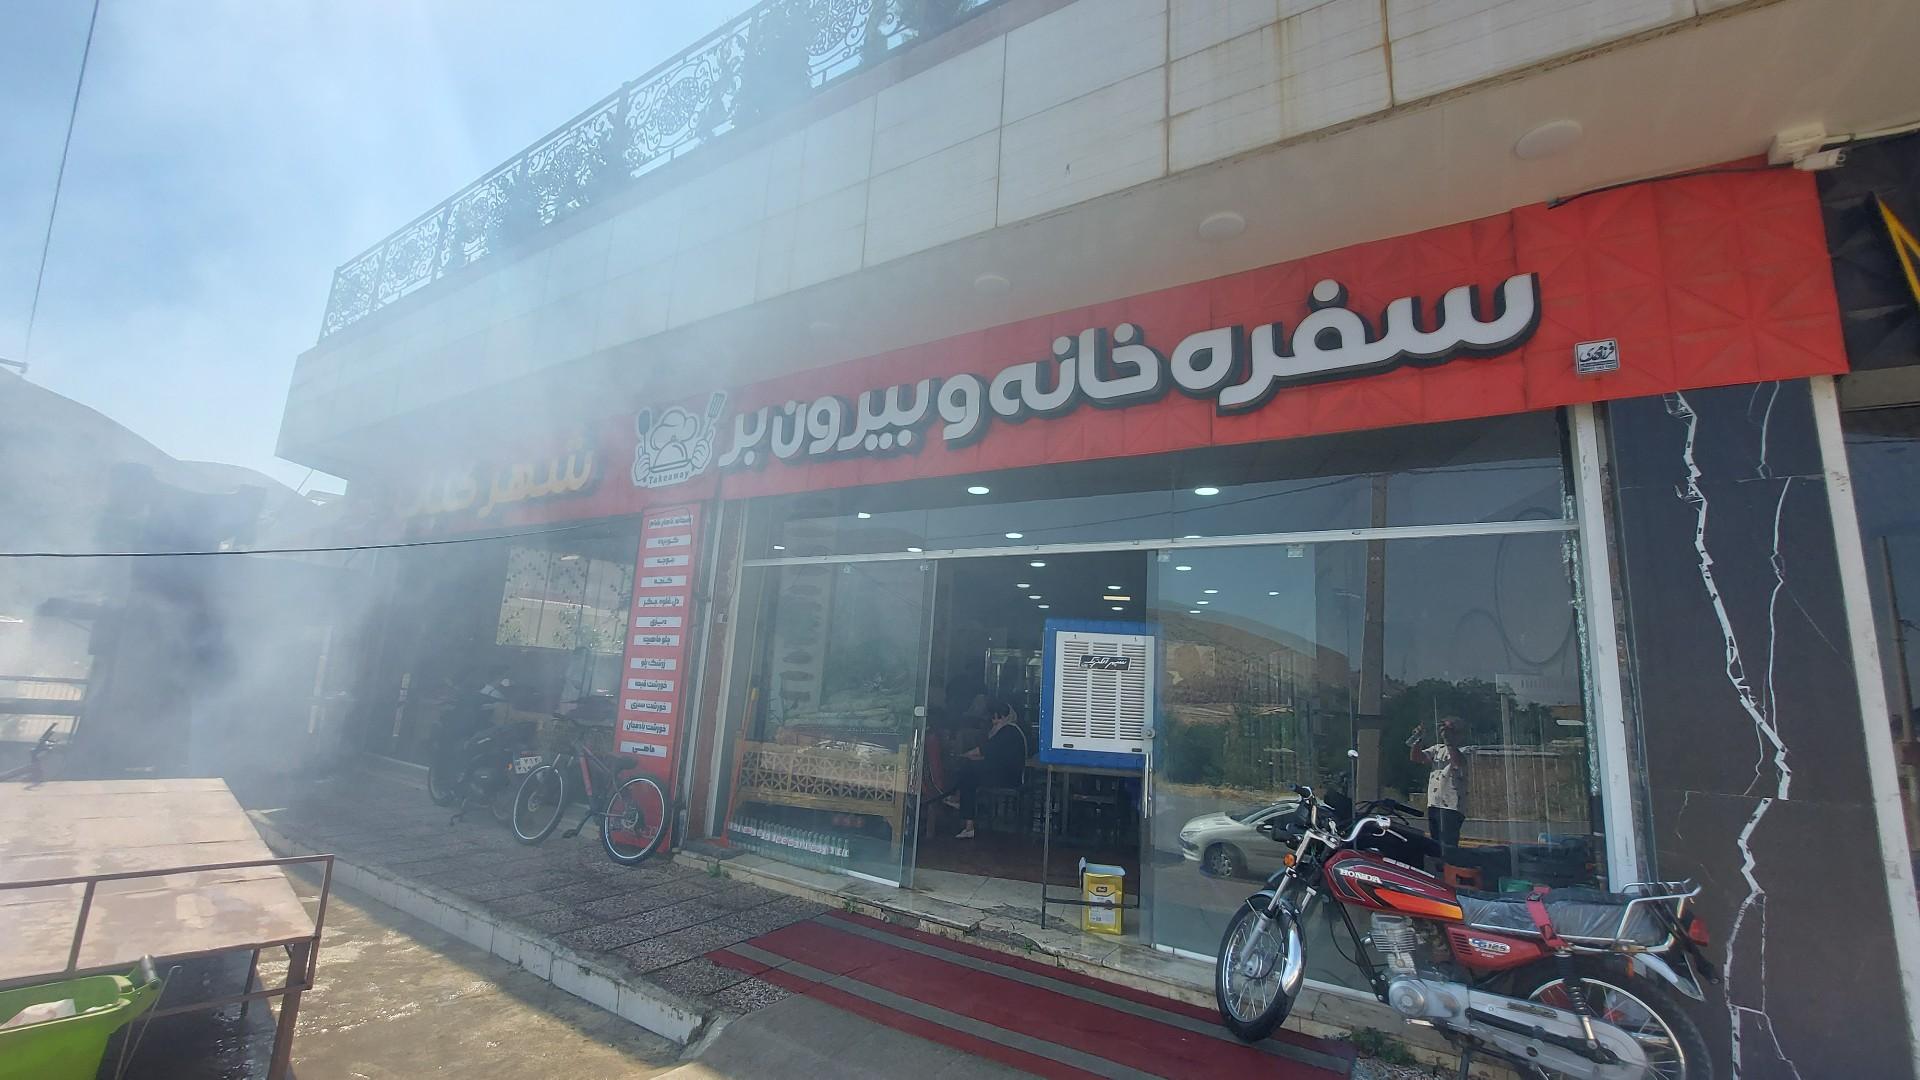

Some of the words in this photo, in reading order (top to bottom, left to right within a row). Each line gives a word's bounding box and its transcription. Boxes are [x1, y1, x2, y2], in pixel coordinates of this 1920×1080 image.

[1171, 272, 1536, 407] سفره
[989, 323, 1159, 416] خانه
[771, 378, 930, 459] بیرون
[938, 374, 981, 441] و
[718, 406, 769, 467] بر
[647, 471, 690, 485] Takeaway
[647, 680, 667, 690] خورشت
[646, 702, 667, 712] خورشت
[646, 723, 666, 733] خورشت
[1340, 869, 1382, 885] HONDA
